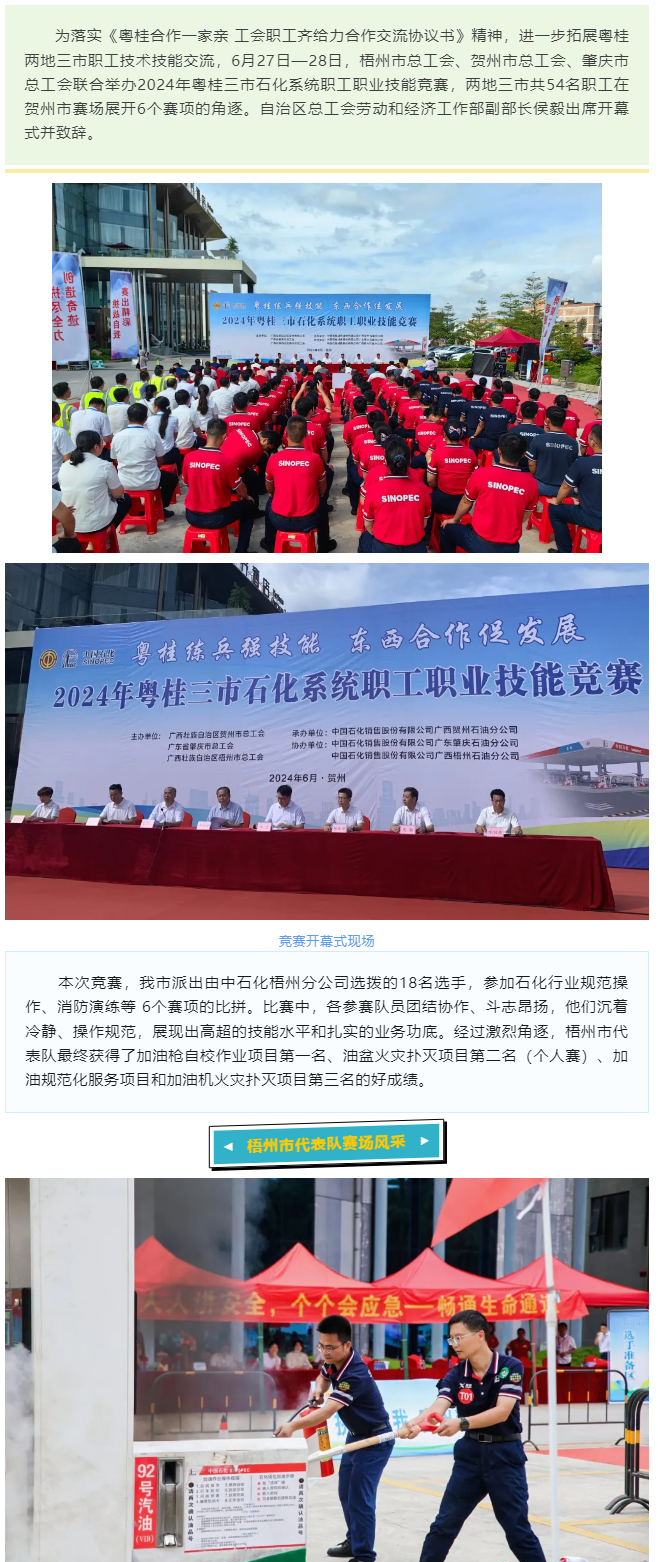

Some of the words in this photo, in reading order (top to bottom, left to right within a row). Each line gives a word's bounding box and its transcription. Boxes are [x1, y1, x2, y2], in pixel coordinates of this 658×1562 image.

[222, 315, 418, 328] 2024年粤桂三市石化系统职工职业技能竞赛
[189, 461, 221, 471] SINOPEC
[487, 481, 526, 496] SINOPEC
[381, 494, 420, 503] SINOPEC
[131, 632, 321, 666] 粤桂练兵强技能
[350, 613, 586, 654] 东西合作促发展
[53, 657, 643, 709] 2024年粤桂三市石化系统职工职业技能竞赛
[331, 725, 518, 736] 中国石化销售股份有限公司广西贺州石油分公司
[168, 741, 234, 751] 广东省肇庆市总工会
[331, 738, 519, 748] 中国石化销售股份有限公司广东肇庆石油分公司
[167, 753, 264, 762] 广西壮族自治区梧州市总工会
[331, 751, 520, 761] 中国石化销售股份有限公司广西梧州石油分公司
[460, 1392, 473, 1400] T01
